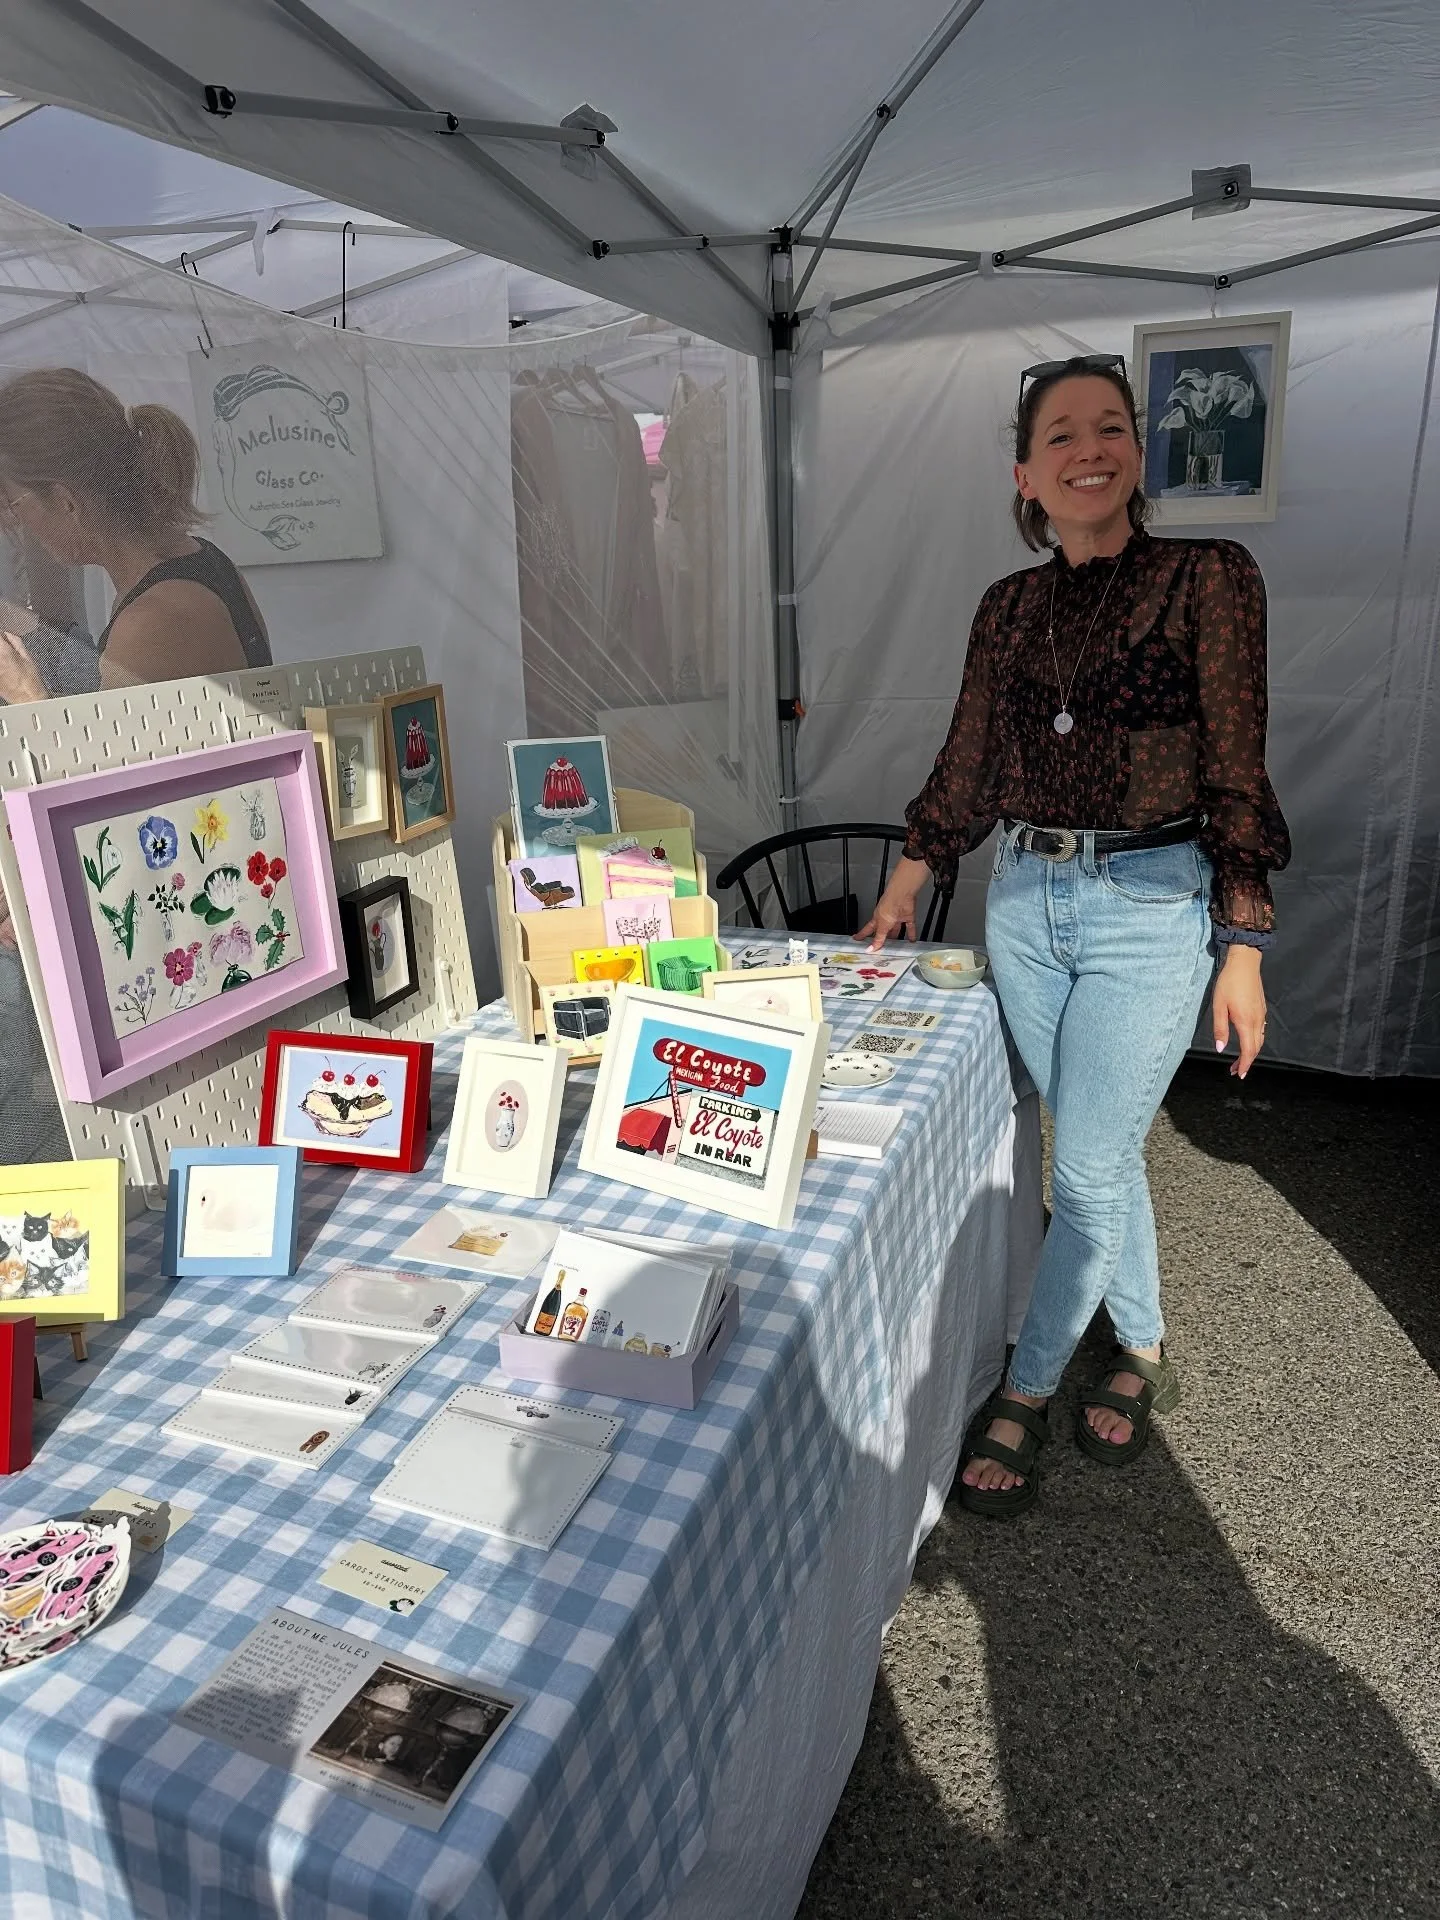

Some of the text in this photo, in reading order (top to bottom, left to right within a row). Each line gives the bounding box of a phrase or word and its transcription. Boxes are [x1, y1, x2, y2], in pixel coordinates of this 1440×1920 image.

[237, 415, 336, 455] Melusine
[255, 469, 295, 489] Glass
[251, 690, 280, 698] PAINTINGS
[663, 1040, 752, 1081] El Coyote
[675, 1067, 740, 1093] MEXICAN Food
[700, 1097, 753, 1120] PARKING
[689, 1109, 763, 1154] El Coyote
[694, 1142, 713, 1157] IN
[714, 1147, 752, 1167] REAR
[108, 1510, 157, 1529] STKERS
[339, 1559, 368, 1574] CARDS
[374, 1572, 426, 1596] STATIONERY
[271, 1617, 311, 1634] ABOUT
[332, 1640, 370, 1658] JULES
